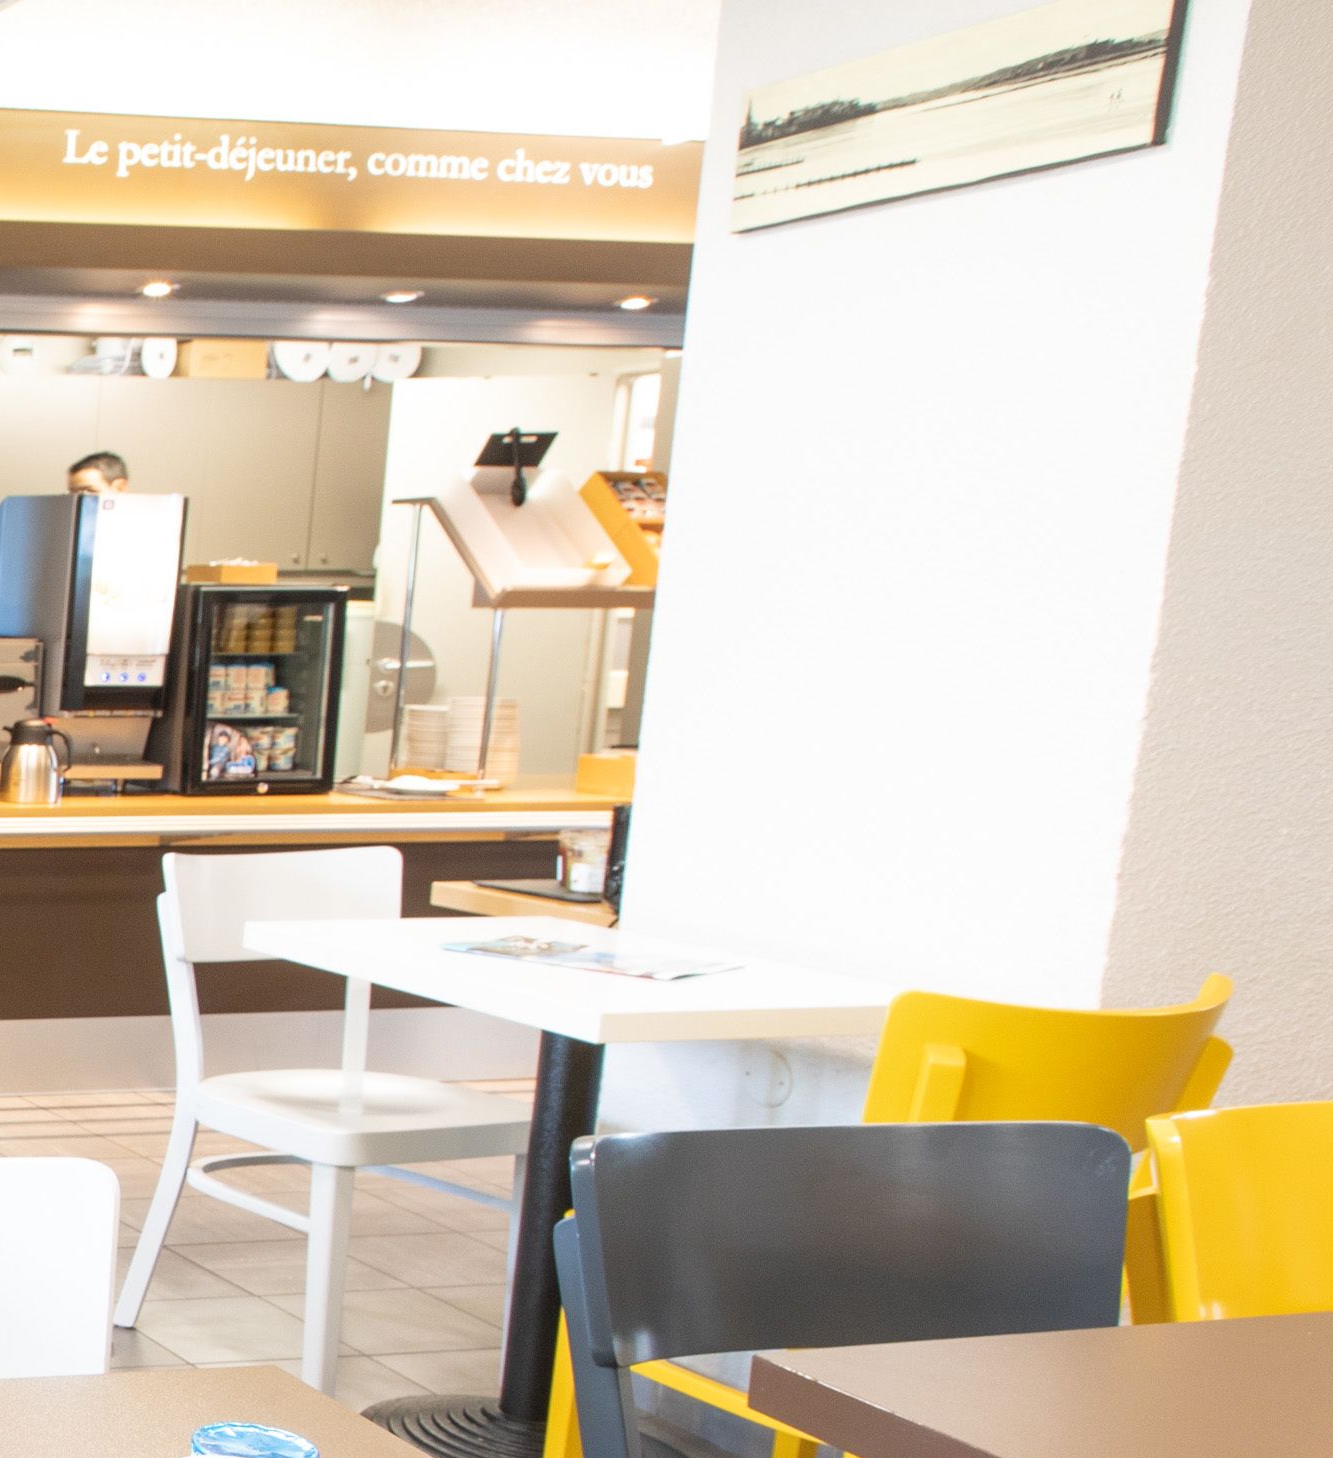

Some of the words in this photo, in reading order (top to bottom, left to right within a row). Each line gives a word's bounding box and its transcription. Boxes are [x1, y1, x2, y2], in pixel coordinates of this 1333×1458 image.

[62, 129, 109, 164] Le
[115, 133, 358, 182] petit-déjeuner,
[366, 152, 489, 181] comme
[496, 148, 572, 184] chez
[579, 161, 653, 189] vous
